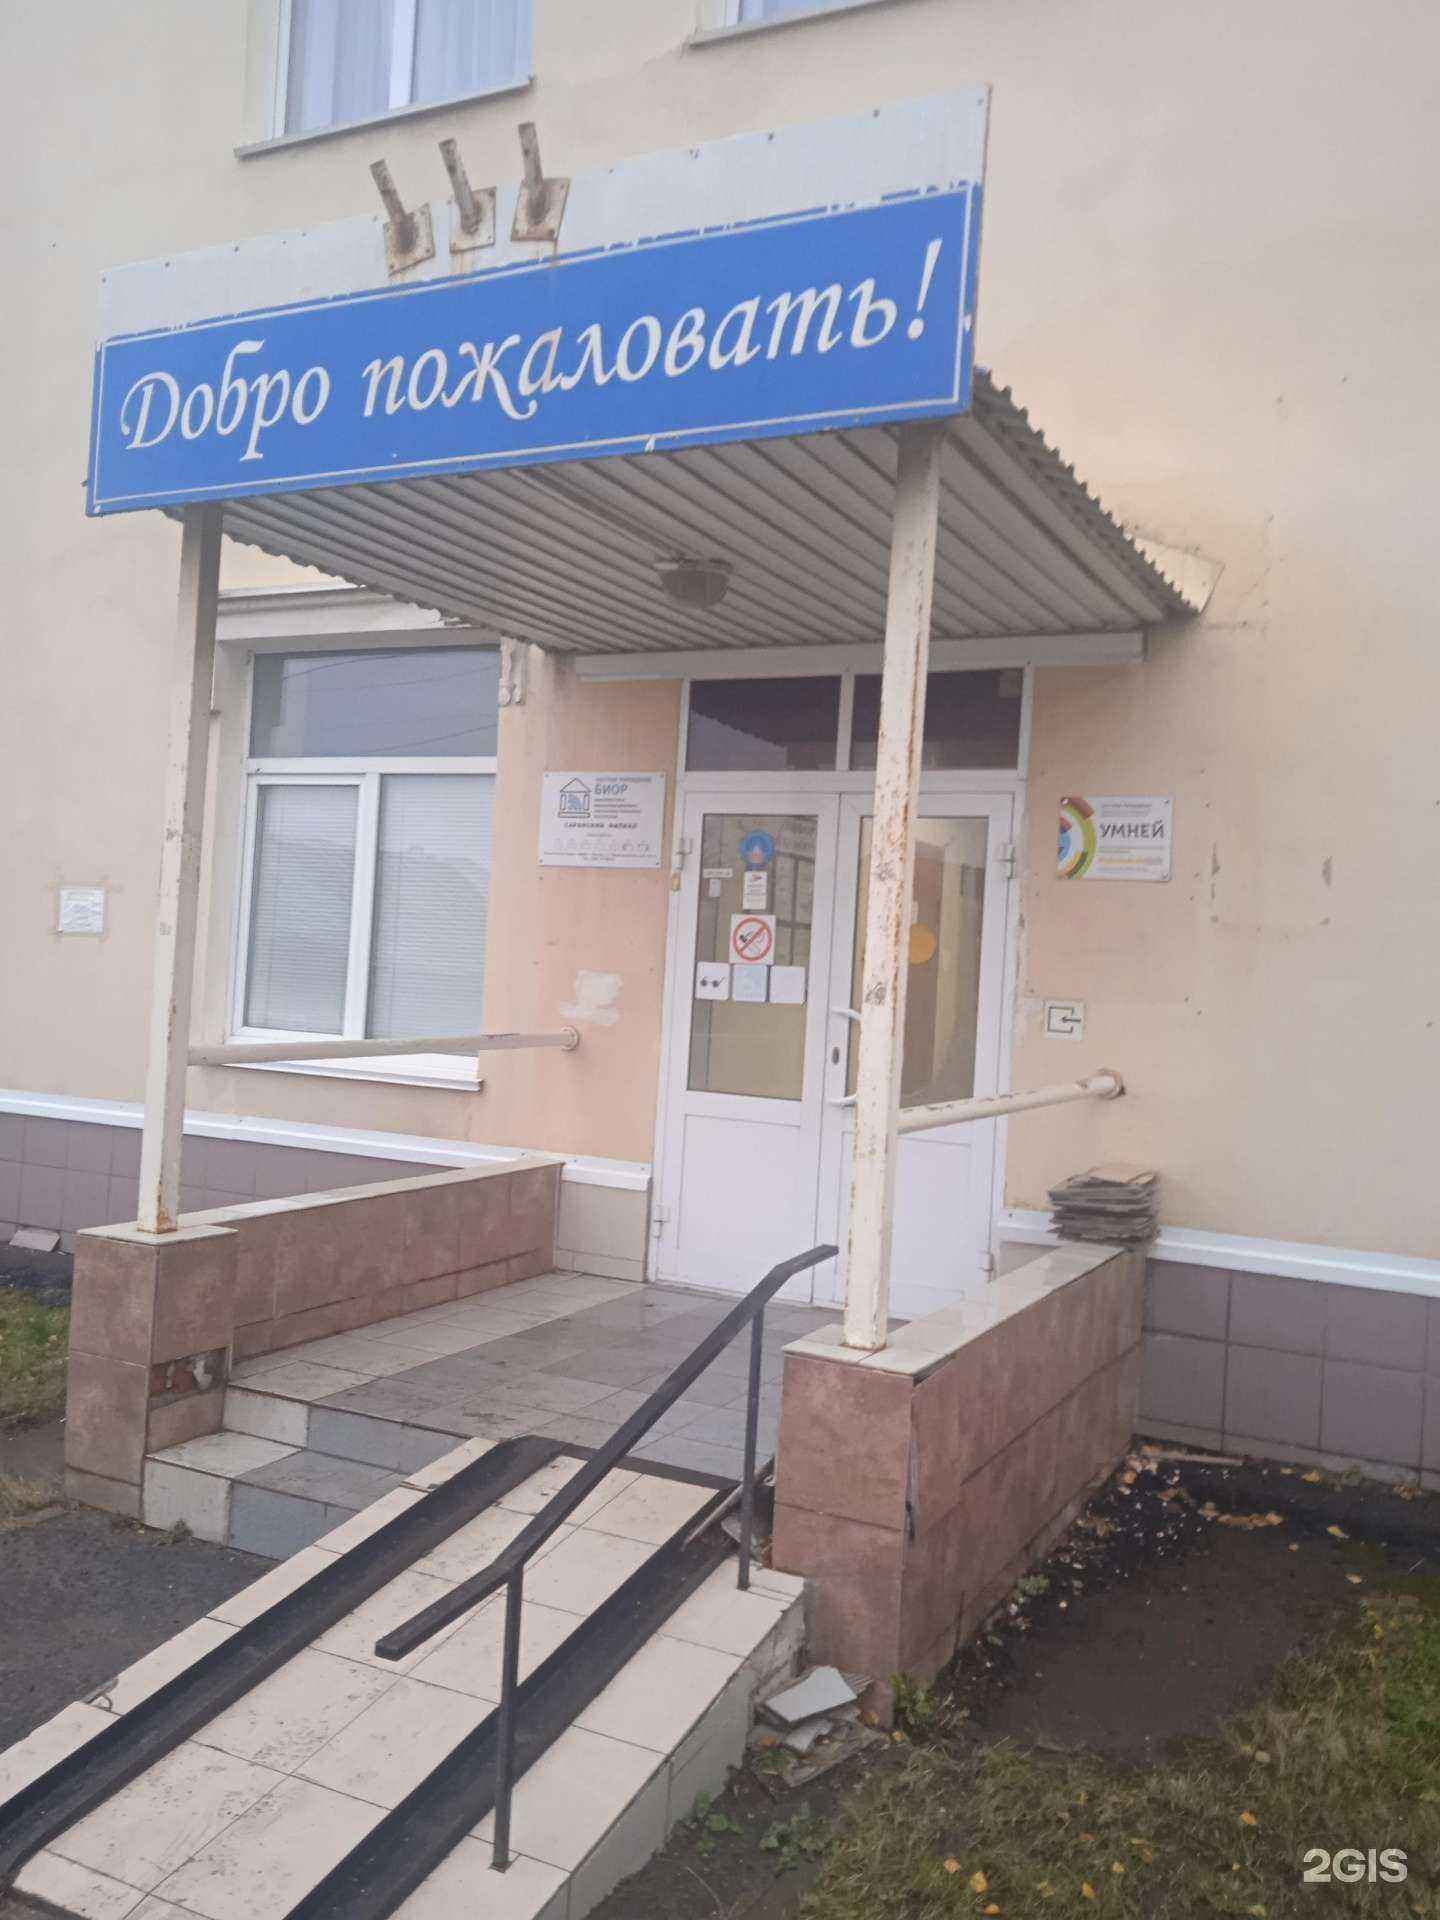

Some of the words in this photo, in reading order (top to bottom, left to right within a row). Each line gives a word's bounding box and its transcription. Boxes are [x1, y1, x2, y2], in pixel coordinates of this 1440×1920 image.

[120, 341, 331, 461] Добро
[363, 239, 942, 421] пожаловать!
[594, 783, 629, 796] БИОР
[1099, 819, 1165, 839] УМНЕЙ
